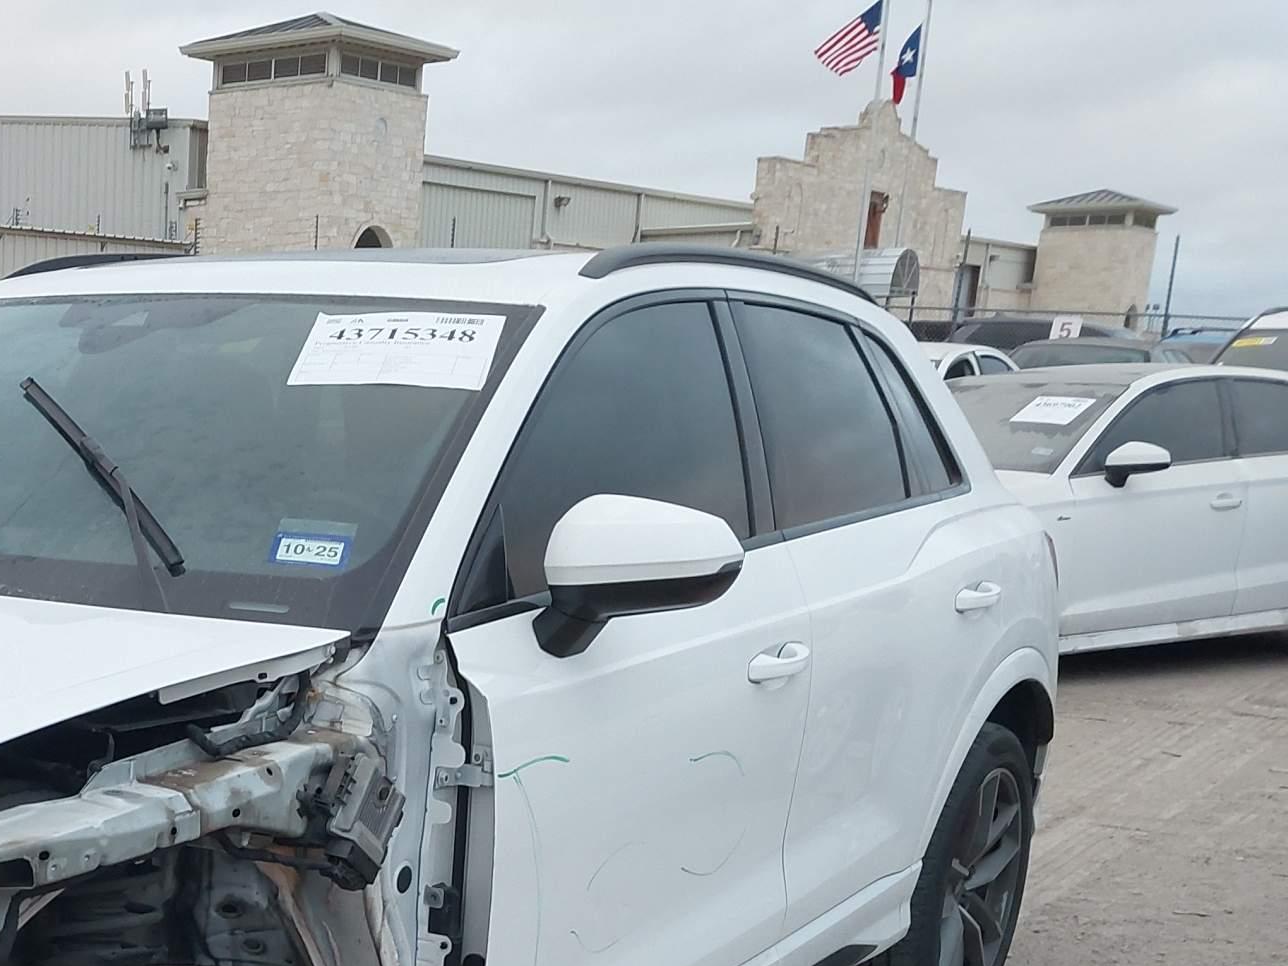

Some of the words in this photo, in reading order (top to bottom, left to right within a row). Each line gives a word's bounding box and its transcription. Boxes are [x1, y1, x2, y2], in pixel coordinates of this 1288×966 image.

[329, 327, 476, 342] 43715348
[1059, 321, 1073, 338] 5
[283, 542, 305, 555] 10
[314, 545, 339, 558] 25
